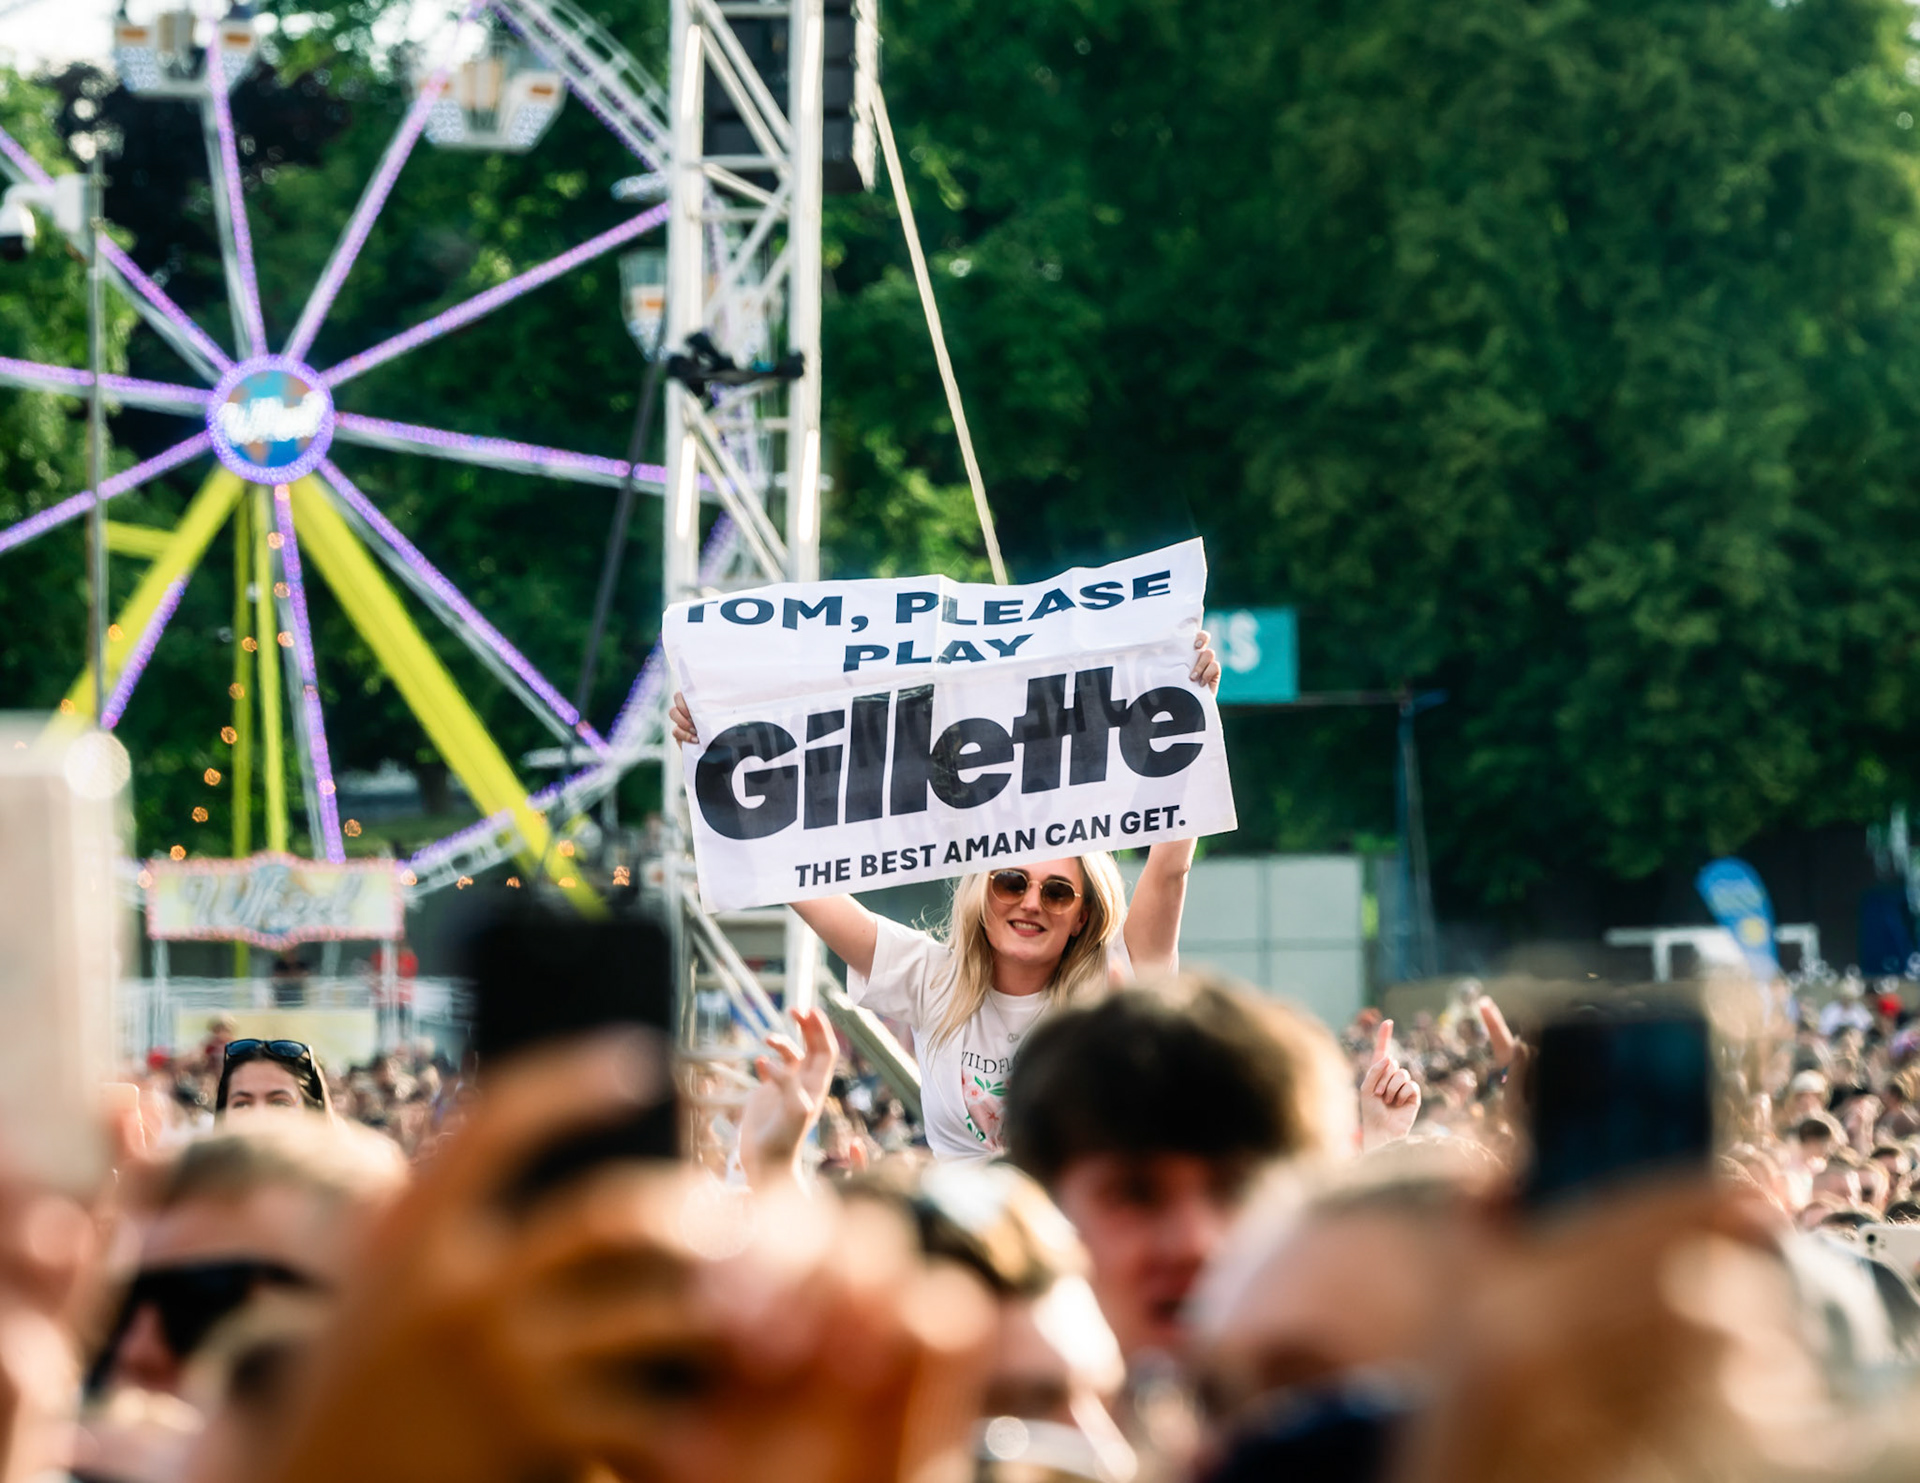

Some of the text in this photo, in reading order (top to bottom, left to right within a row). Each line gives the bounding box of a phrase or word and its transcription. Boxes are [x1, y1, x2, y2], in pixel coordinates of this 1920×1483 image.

[687, 569, 1171, 633] TOM, PLEASE
[843, 633, 1033, 673] PLAY
[694, 665, 1206, 841] Gillette
[795, 857, 851, 888] THE
[860, 843, 937, 878] BEST
[1045, 814, 1111, 847] CAN
[1120, 804, 1187, 835] GET.
[961, 1051, 1014, 1074] ILDFL
